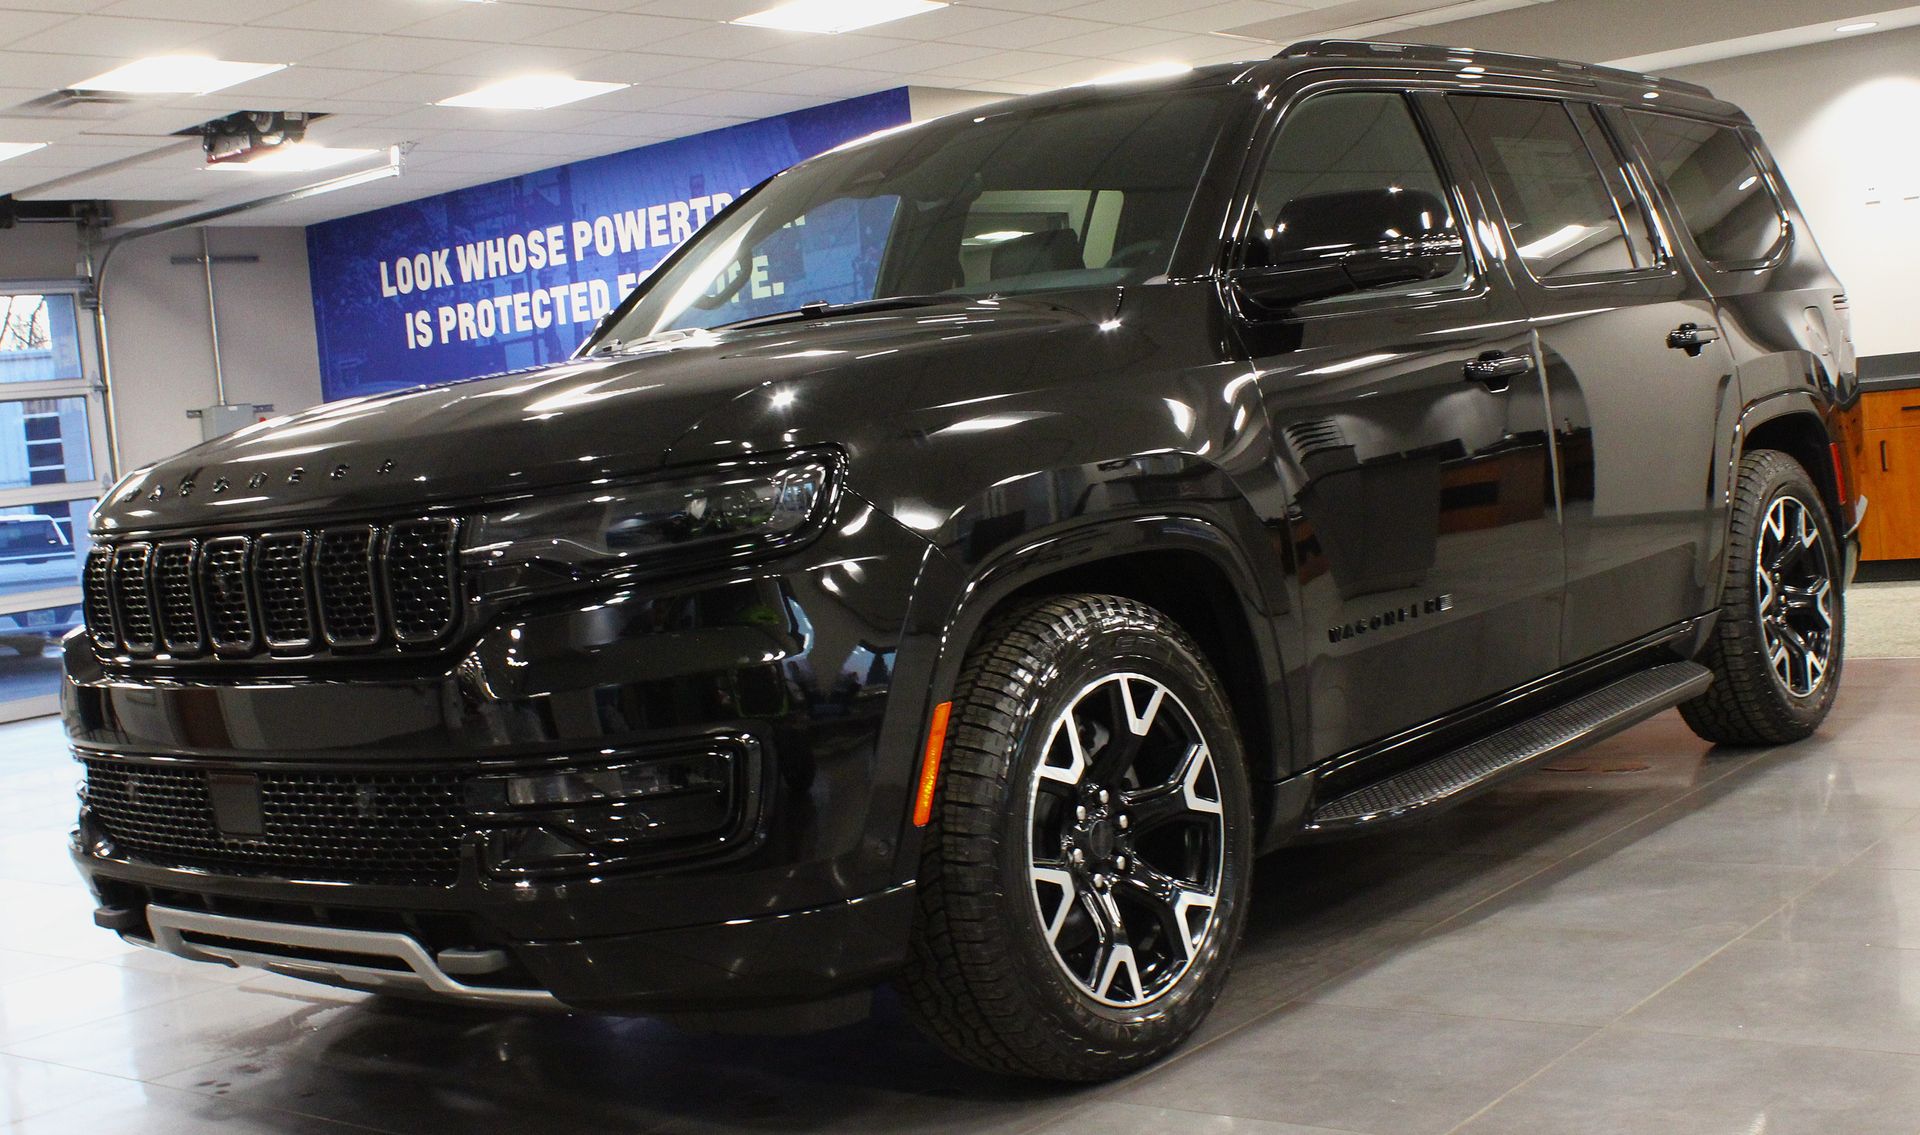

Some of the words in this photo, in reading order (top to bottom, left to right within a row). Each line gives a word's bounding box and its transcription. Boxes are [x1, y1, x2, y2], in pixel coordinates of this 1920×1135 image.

[379, 248, 453, 298] LOOK
[456, 225, 567, 283] WHOSE
[572, 187, 806, 262] POWERT
[405, 310, 433, 349] IS
[438, 279, 610, 344] PROTECTED
